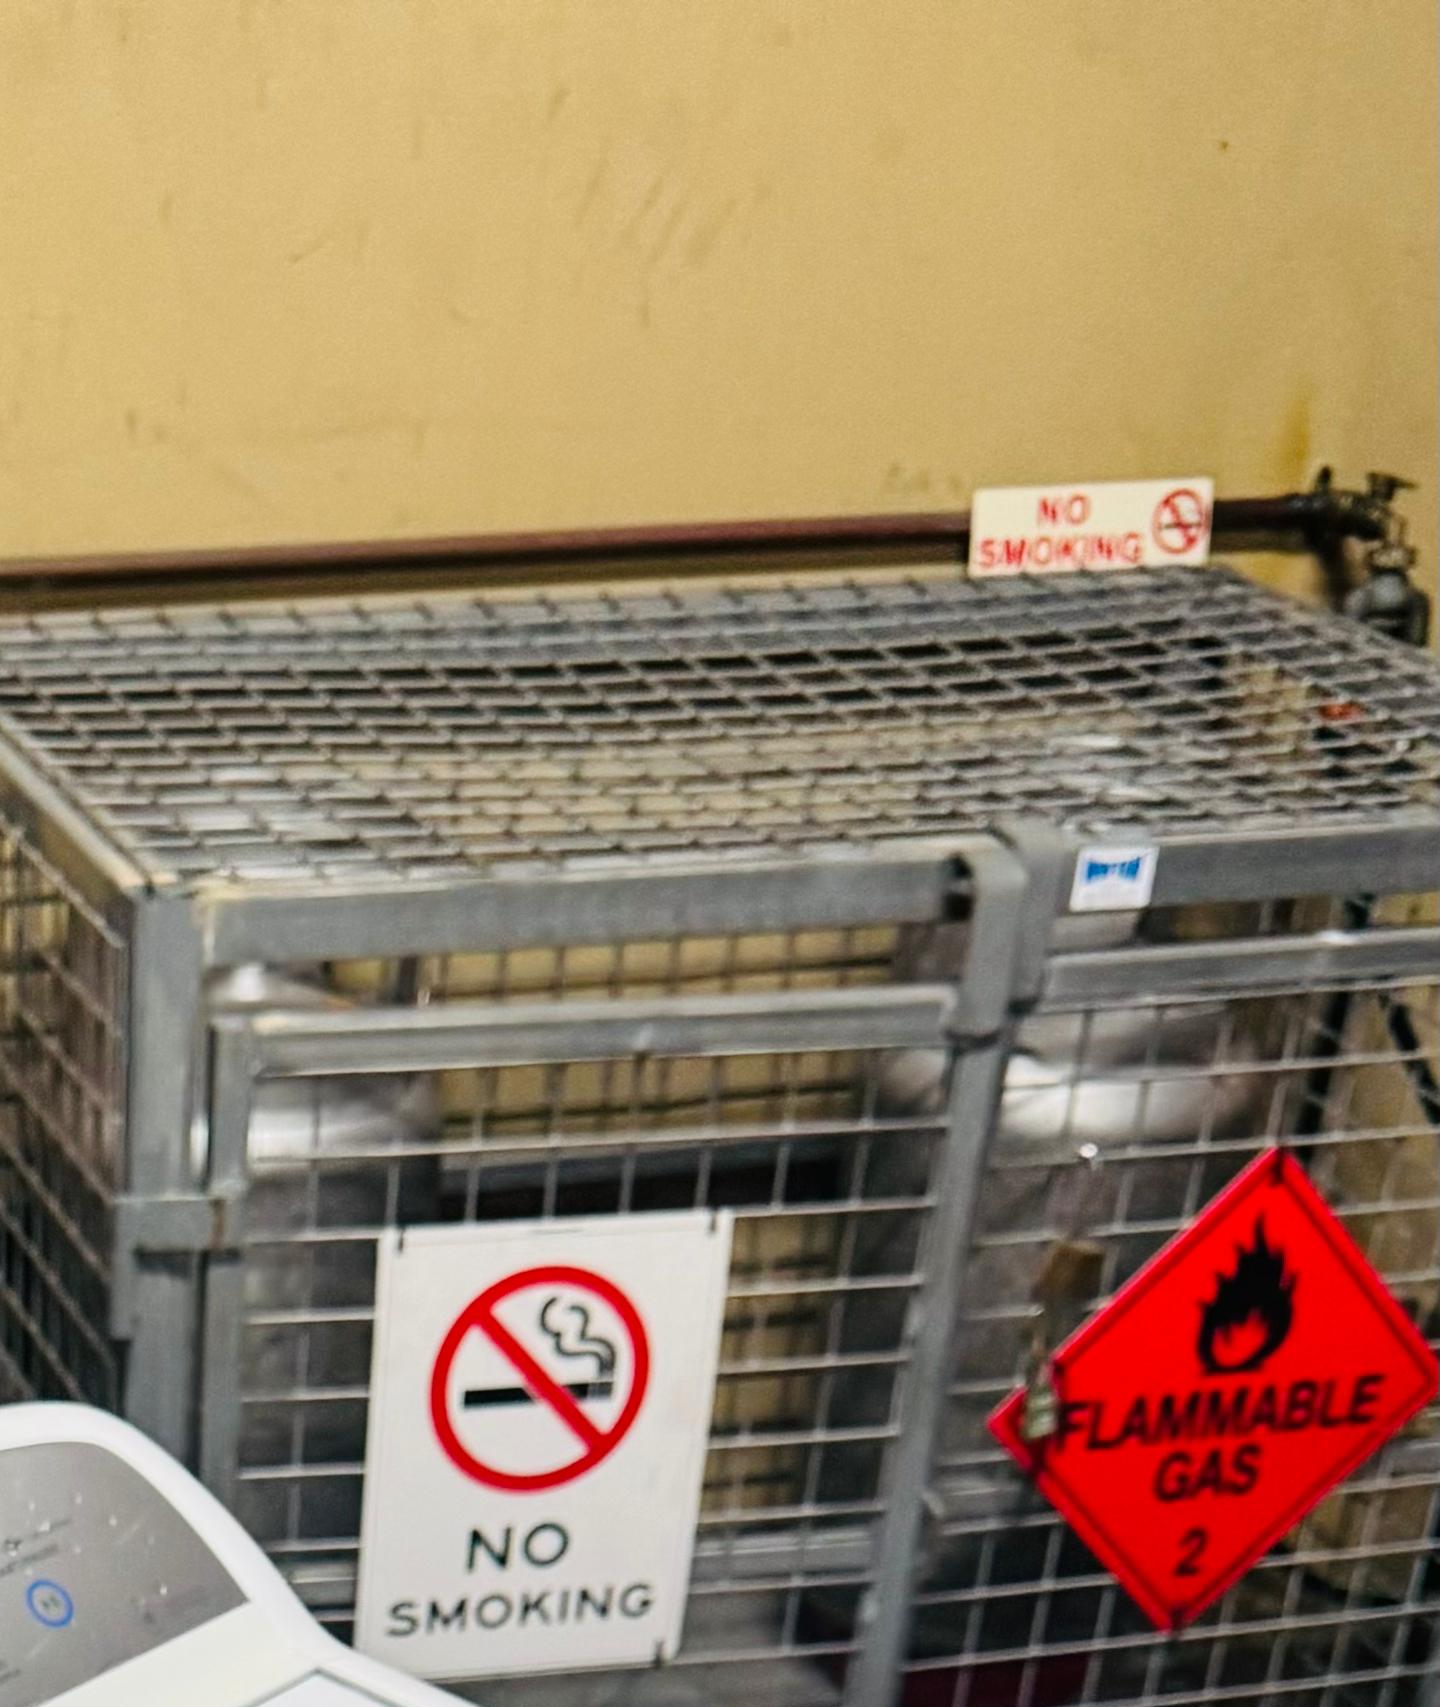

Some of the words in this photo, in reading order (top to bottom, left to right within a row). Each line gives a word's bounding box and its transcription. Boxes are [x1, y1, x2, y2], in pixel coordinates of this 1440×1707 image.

[1037, 493, 1090, 526] NO
[979, 531, 1142, 568] SMOKING
[1055, 1374, 1385, 1452] FLAMMABLE
[1153, 1444, 1263, 1503] GAS
[465, 1521, 570, 1574] NO
[1173, 1526, 1208, 1577] 2
[385, 1582, 654, 1638] SMOKING
